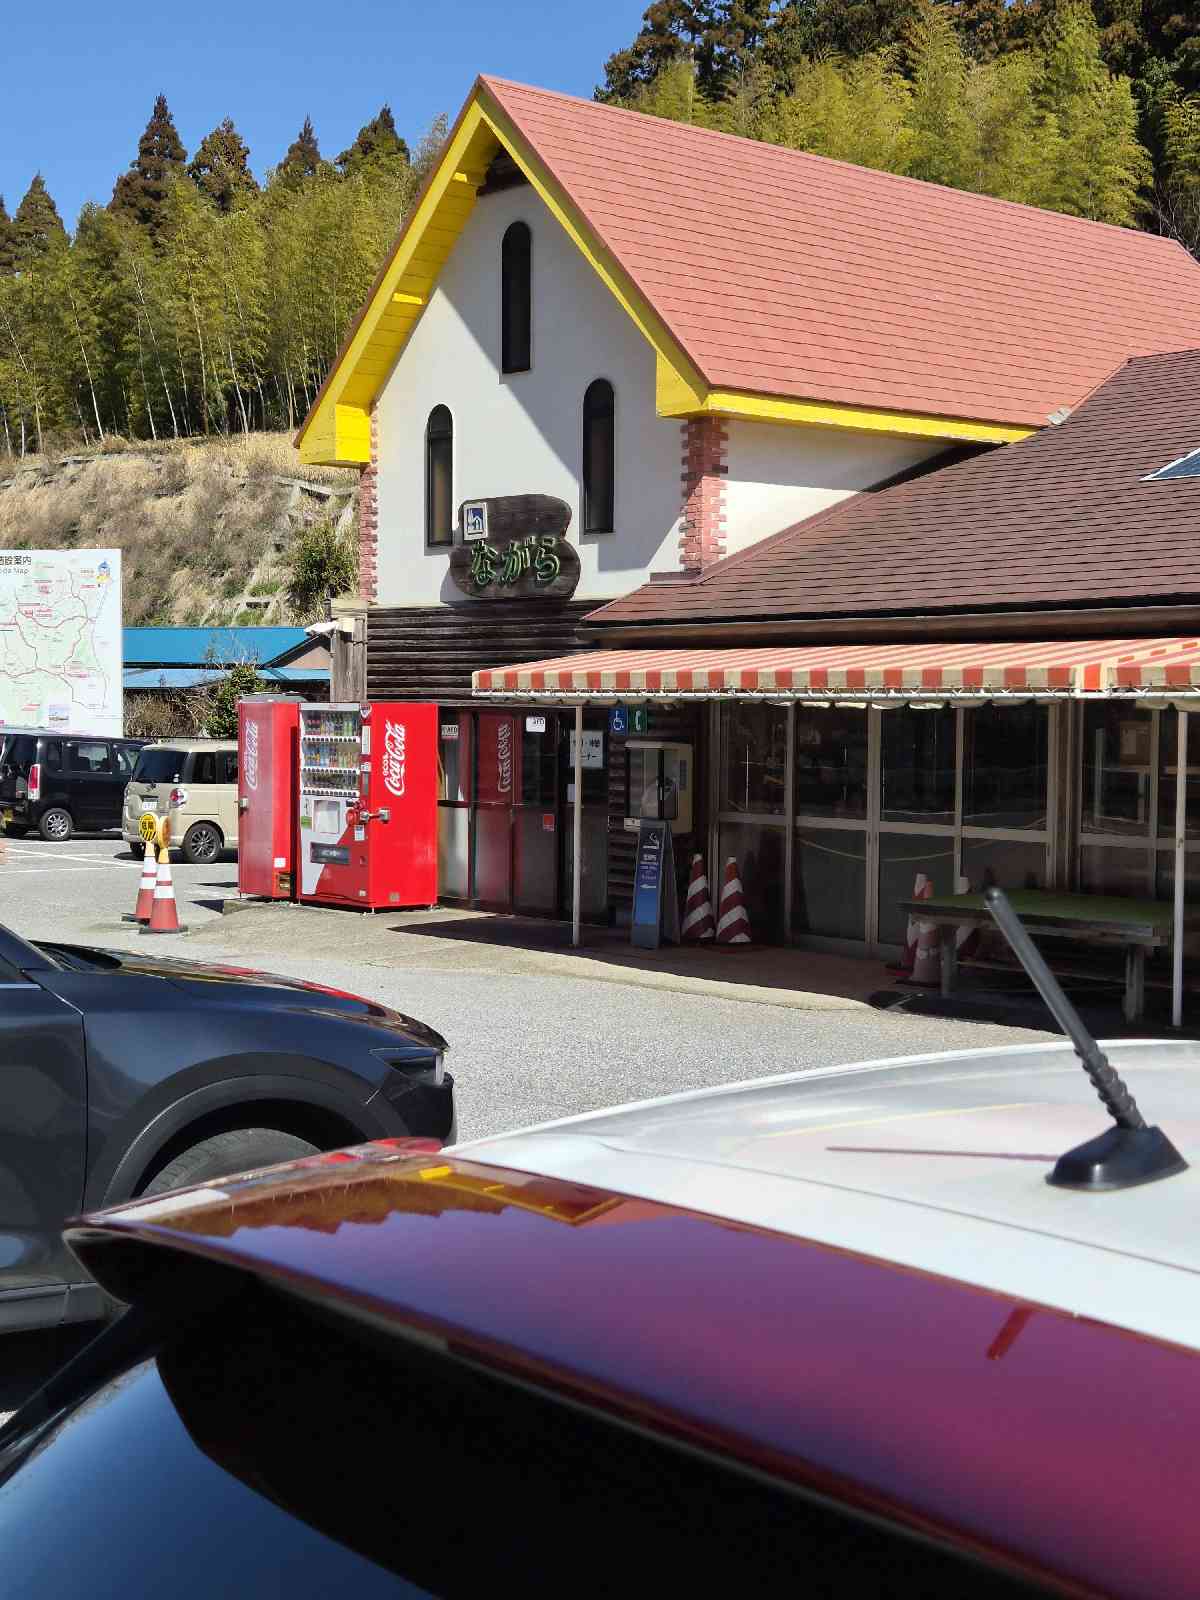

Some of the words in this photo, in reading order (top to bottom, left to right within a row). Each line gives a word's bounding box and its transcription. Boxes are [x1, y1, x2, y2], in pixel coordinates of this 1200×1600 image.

[472, 536, 560, 585] ながら
[246, 718, 257, 790] Coca-Cola
[385, 719, 405, 797] Coca-Cola
